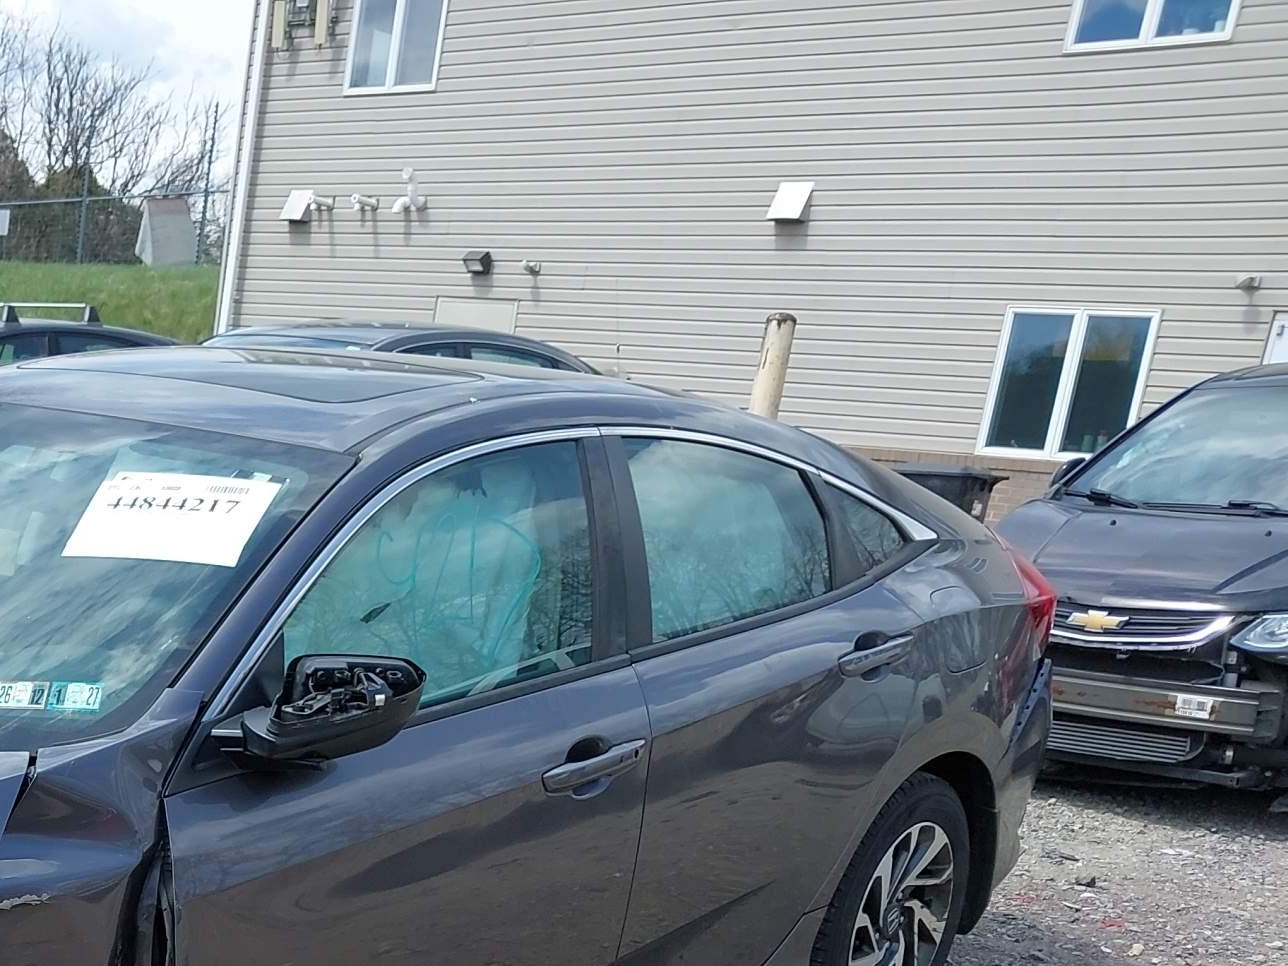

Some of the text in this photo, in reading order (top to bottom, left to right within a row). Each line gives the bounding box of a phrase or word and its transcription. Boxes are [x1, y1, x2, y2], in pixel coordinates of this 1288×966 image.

[106, 495, 241, 514] 44844217
[29, 688, 46, 705] 12
[54, 687, 63, 706] 1
[85, 686, 100, 706] 27
